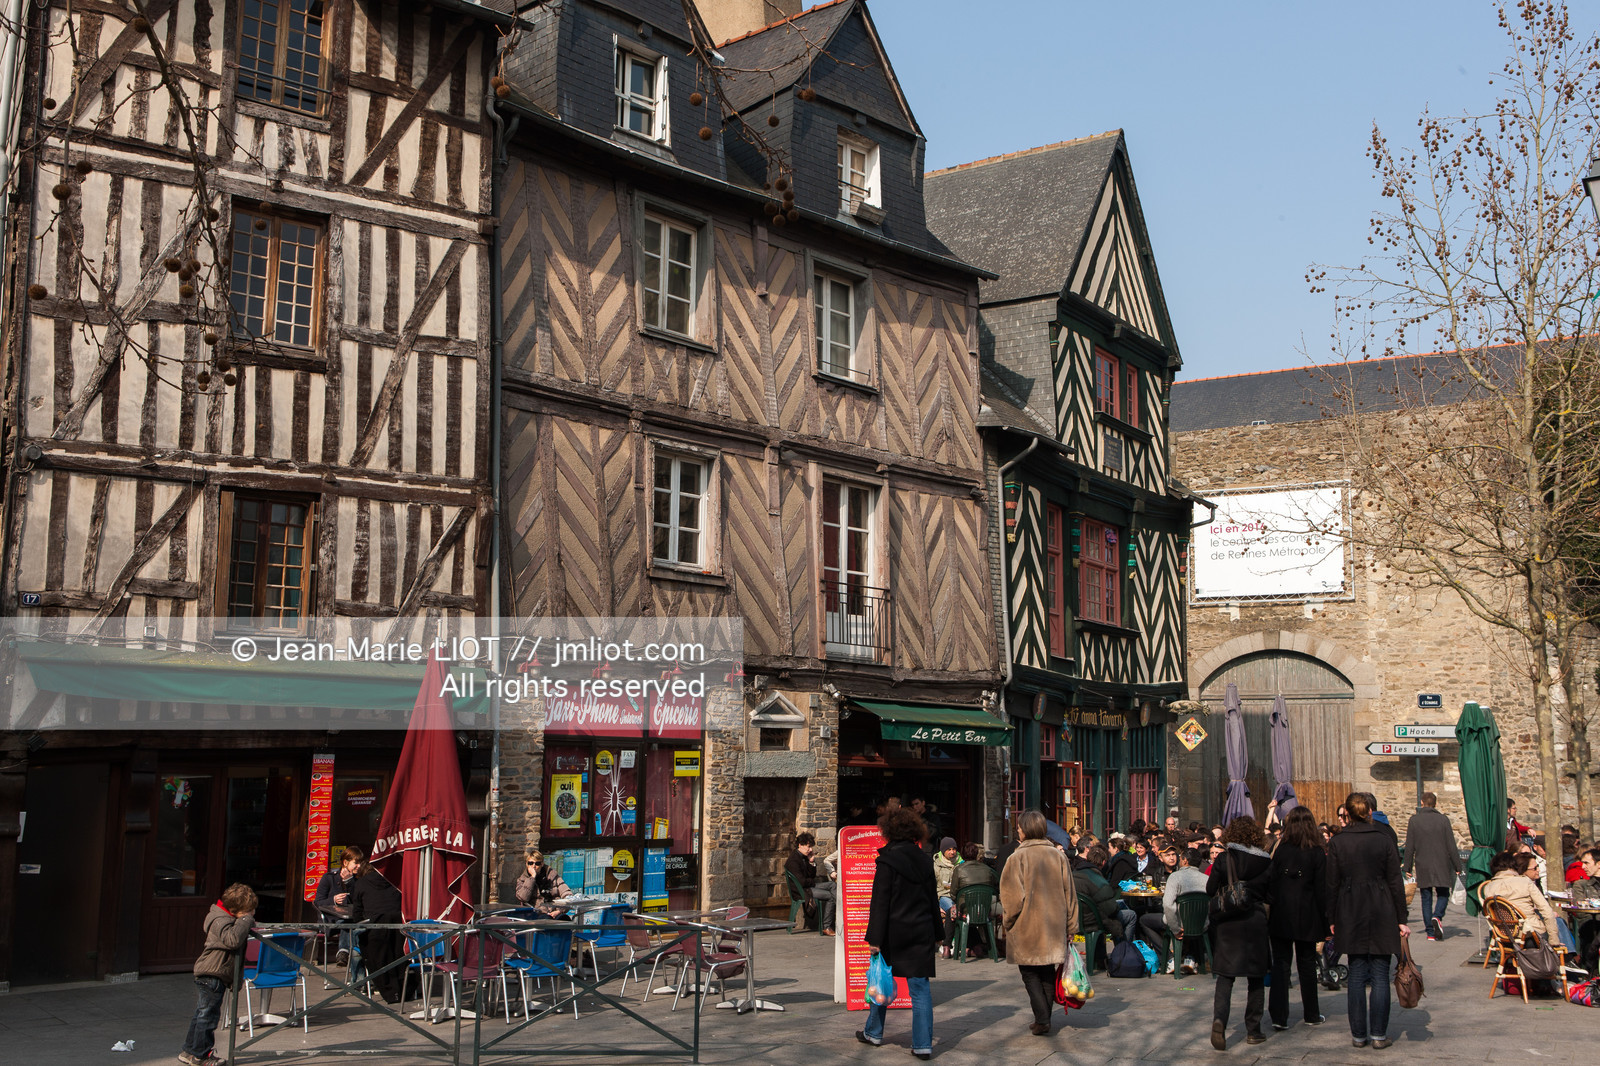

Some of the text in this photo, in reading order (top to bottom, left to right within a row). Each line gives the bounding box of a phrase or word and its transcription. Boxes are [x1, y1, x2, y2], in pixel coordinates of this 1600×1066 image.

[1210, 524, 1222, 534] Ici
[1226, 525, 1239, 533] en
[1210, 538, 1220, 548] le
[1210, 546, 1326, 560] de Rennes Métropole
[26, 595, 38, 603] 17
[545, 688, 620, 726] Taxi-Phone
[911, 726, 986, 743] Le Petit Bar
[348, 788, 372, 796] NOUVEAU
[446, 830, 463, 847] LA
